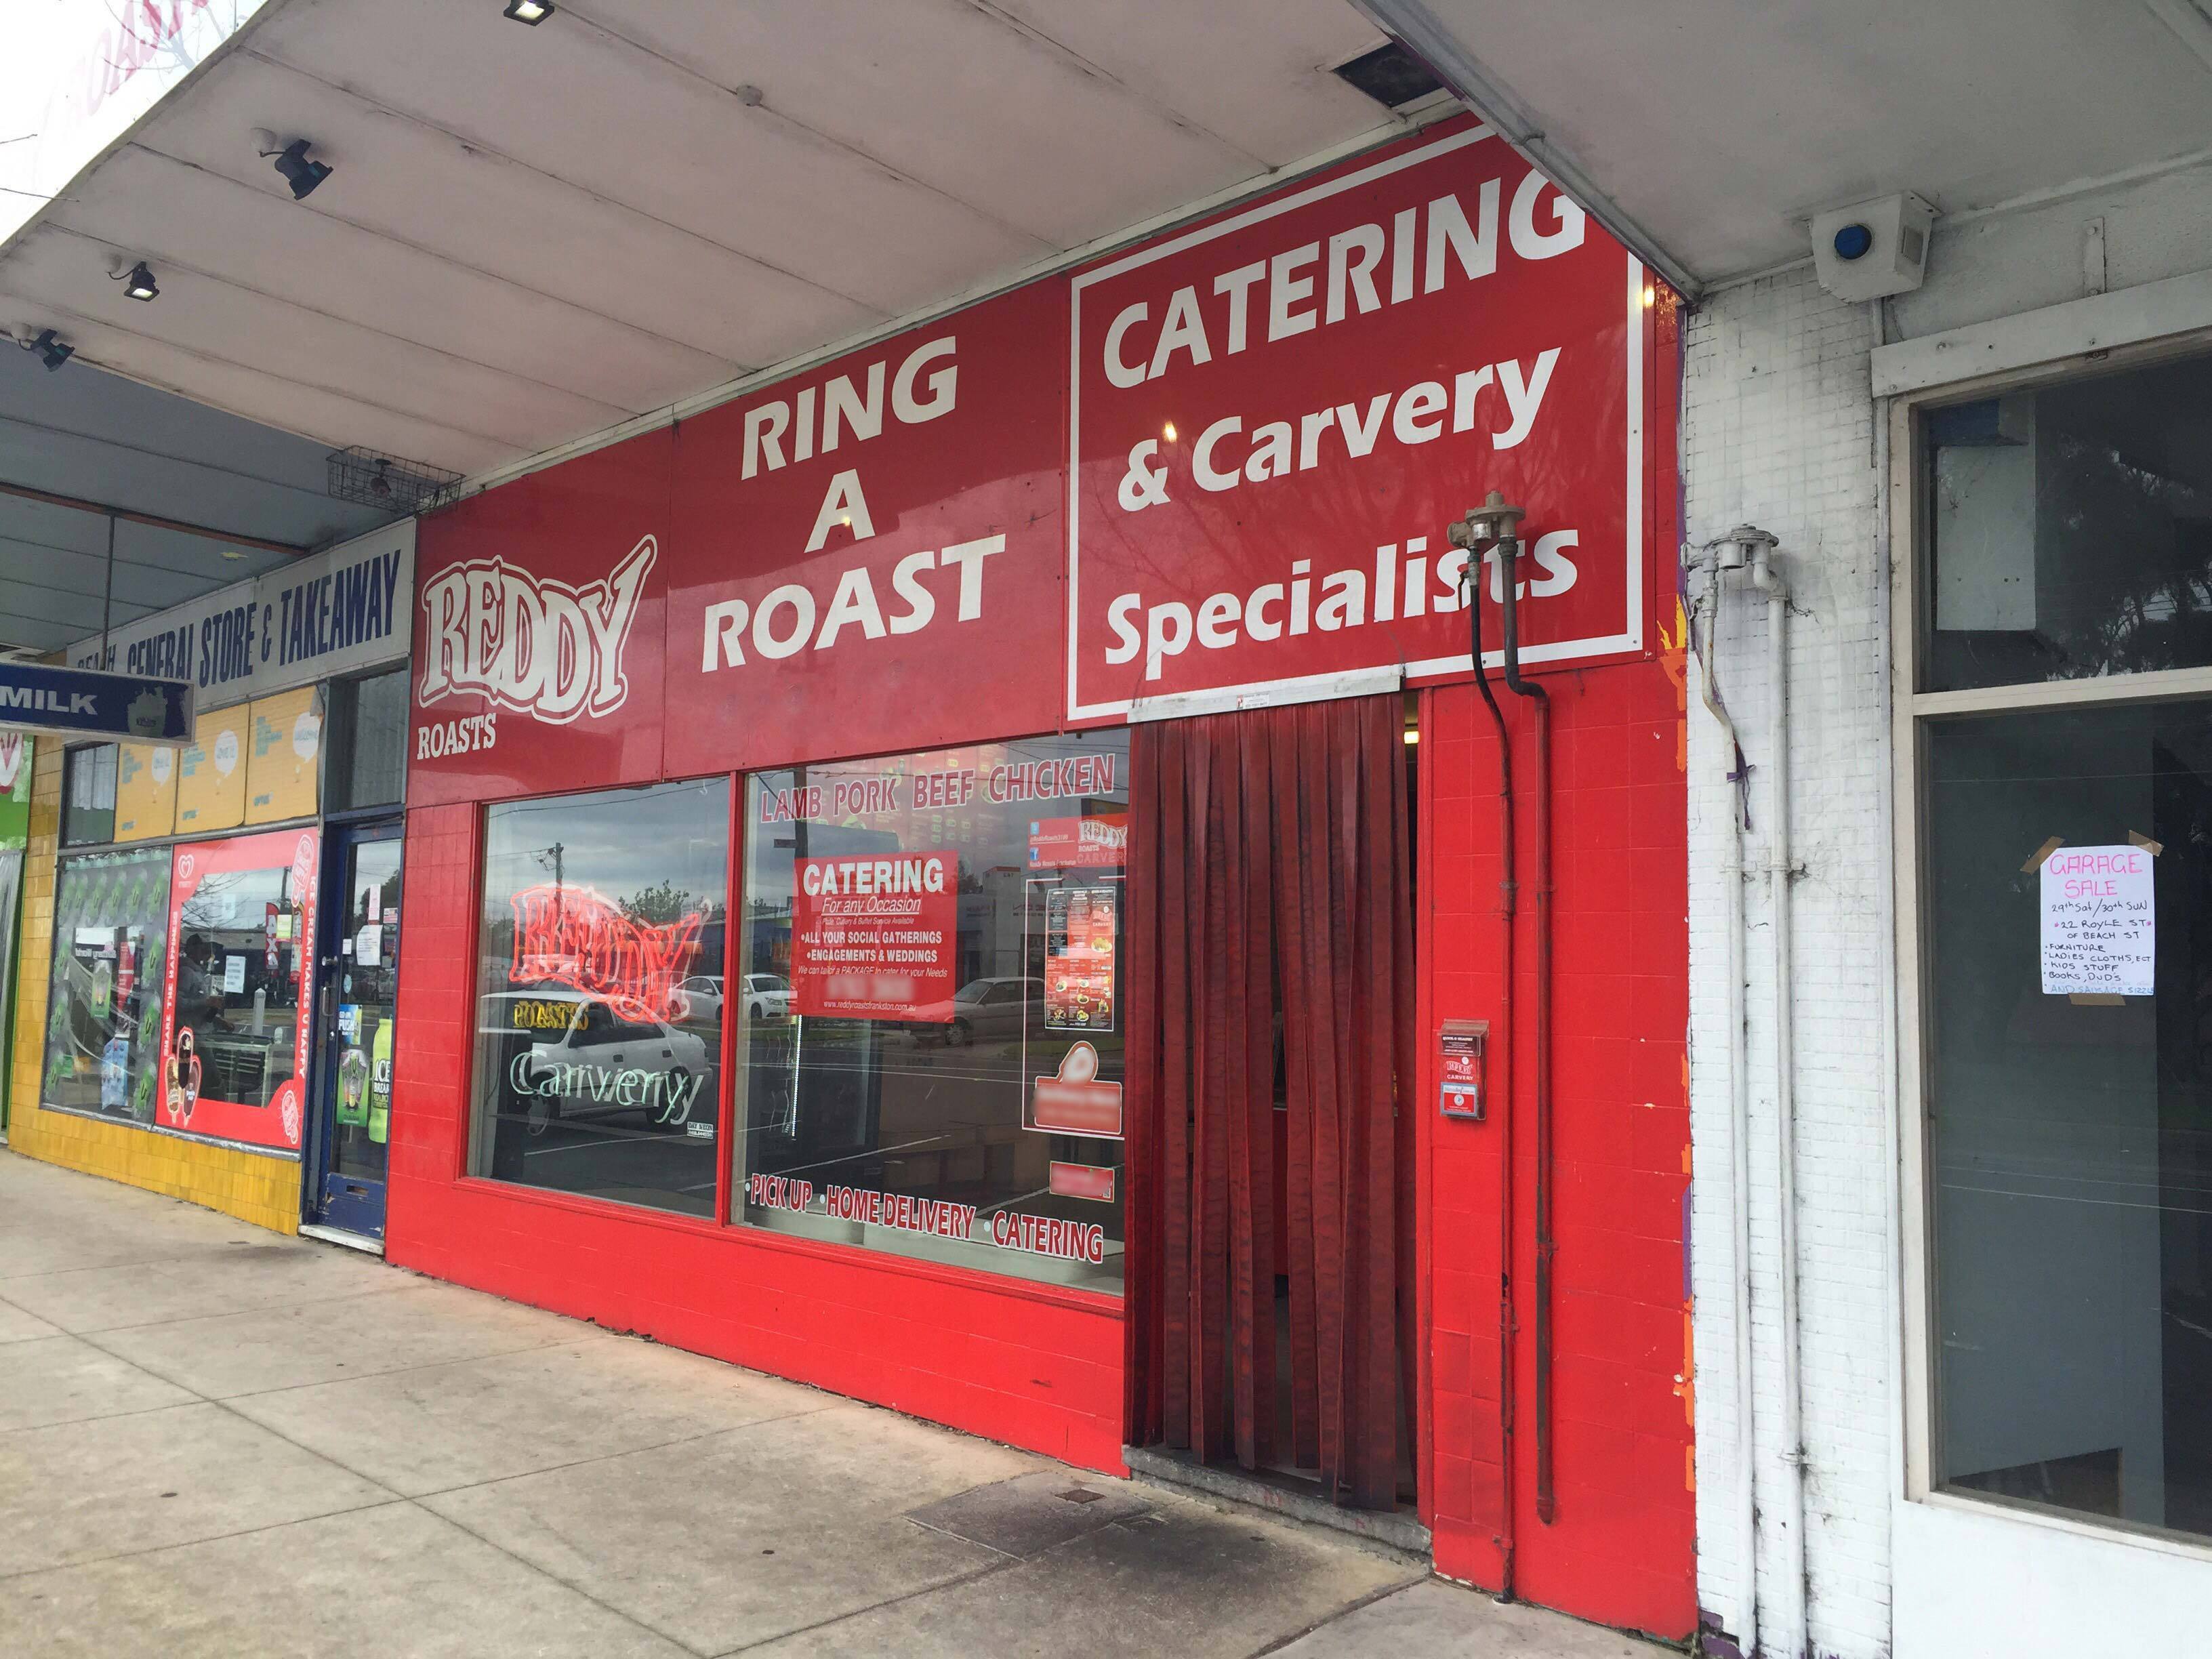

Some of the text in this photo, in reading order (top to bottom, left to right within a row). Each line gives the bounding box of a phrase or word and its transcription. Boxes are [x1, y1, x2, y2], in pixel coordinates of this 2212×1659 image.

[1103, 168, 1586, 389] CATERING
[741, 335, 958, 480] RING
[1118, 347, 1563, 512] & Carvery
[804, 468, 876, 554] A
[199, 602, 258, 689] STORE
[261, 603, 272, 663] &
[279, 550, 401, 666] TAKEAWAY
[702, 534, 1006, 674] ROAST
[1105, 529, 1580, 681] Specialists
[419, 534, 657, 724] REDDY
[0, 686, 98, 716] MILK
[417, 712, 497, 760] ROASTS
[760, 753, 1116, 824] LAMB PORK BEEF CHICKEN
[803, 858, 943, 897] CATERING
[1077, 852, 1126, 864] CARVER
[2050, 854, 2143, 875] GARAGE
[822, 896, 922, 916] For any Occasion
[2064, 880, 2118, 899] SALE
[306, 907, 314, 956] CREAM
[822, 931, 846, 944] YOUR
[848, 931, 880, 944] SOCIAL
[882, 931, 942, 944] GATHERINGS
[2049, 943, 2106, 952] FURNITURE
[2061, 921, 2078, 929] 22
[798, 966, 808, 975] We
[842, 966, 874, 975] PACKAGE
[910, 969, 925, 978] your
[926, 967, 947, 977] Needs
[811, 949, 938, 962] ENGAGEMENTS & WEDDINGS
[2051, 961, 2076, 969] KIDS
[303, 962, 312, 1008] MAKES
[298, 1028, 308, 1079] HAPPY
[374, 1059, 391, 1082] ICE
[510, 1052, 690, 1124] Carvery
[751, 1172, 1104, 1265] PICK UP HOME DELIVERY CATERING
